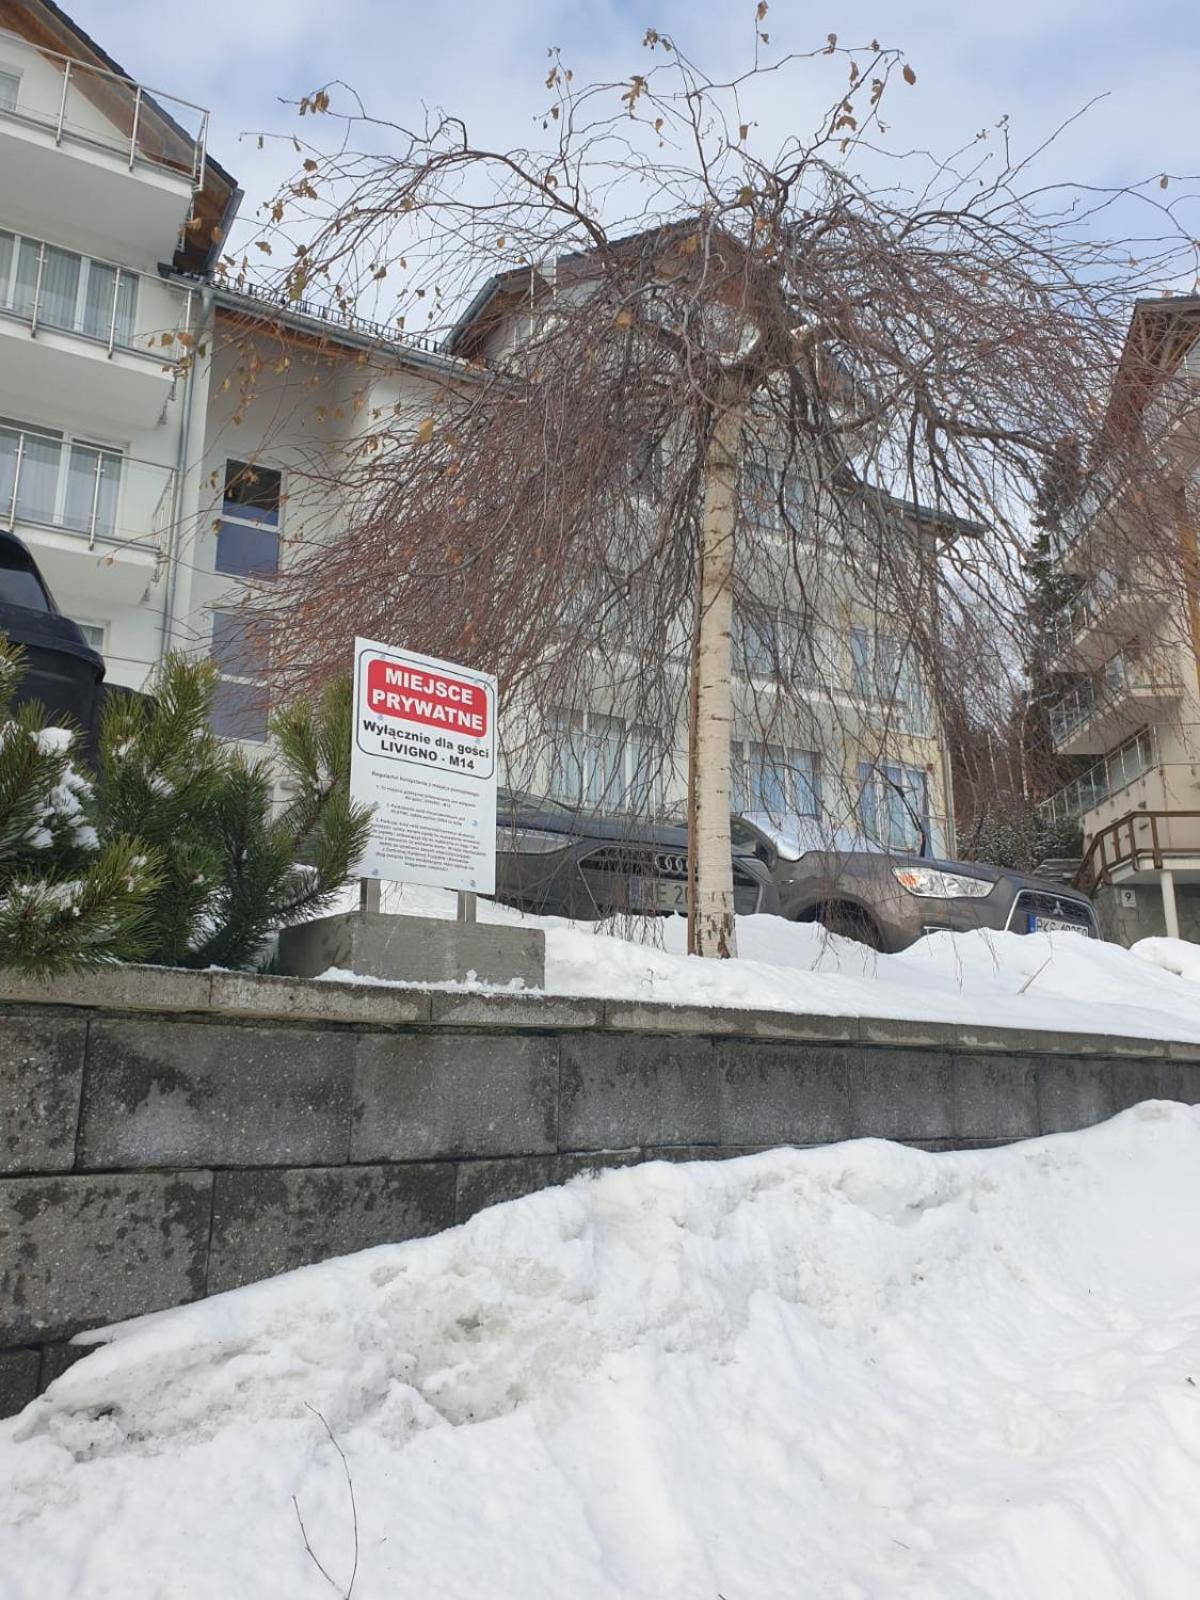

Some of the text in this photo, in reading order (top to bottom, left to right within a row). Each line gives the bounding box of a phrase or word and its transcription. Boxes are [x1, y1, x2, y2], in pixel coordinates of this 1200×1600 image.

[385, 668, 473, 705] MIEJSCE
[372, 688, 484, 731] PRYWATNE
[363, 720, 489, 758] Wyłącznie dla gości
[381, 740, 438, 761] LIVIGNO
[449, 755, 475, 770] M14
[1125, 892, 1131, 901] 9
